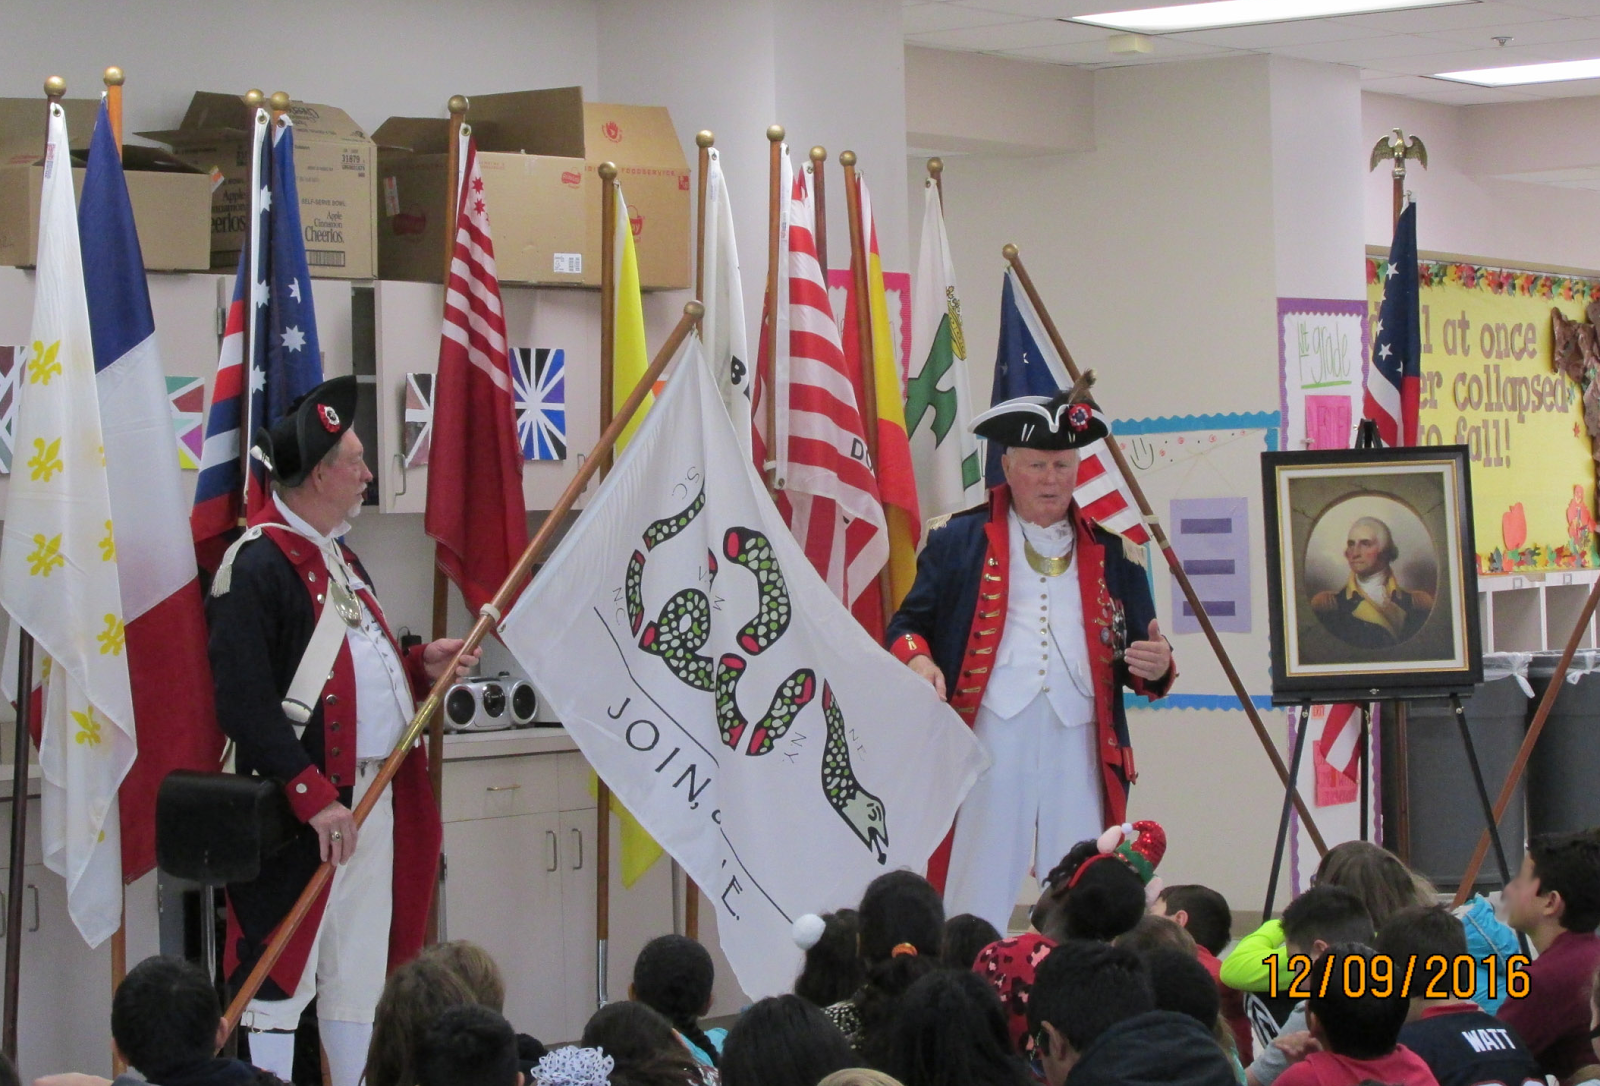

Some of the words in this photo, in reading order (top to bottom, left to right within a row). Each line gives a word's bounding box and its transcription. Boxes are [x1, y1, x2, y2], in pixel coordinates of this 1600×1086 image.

[305, 226, 344, 243] Cheerios
[314, 218, 342, 228] Cinnamon
[327, 211, 342, 222] Apple
[1311, 321, 1351, 384] grade
[1443, 310, 1470, 357] at
[1480, 322, 1537, 361] once
[1454, 364, 1569, 424] collapsed
[607, 697, 712, 810] JOIN,
[1461, 1028, 1517, 1053] WATT
